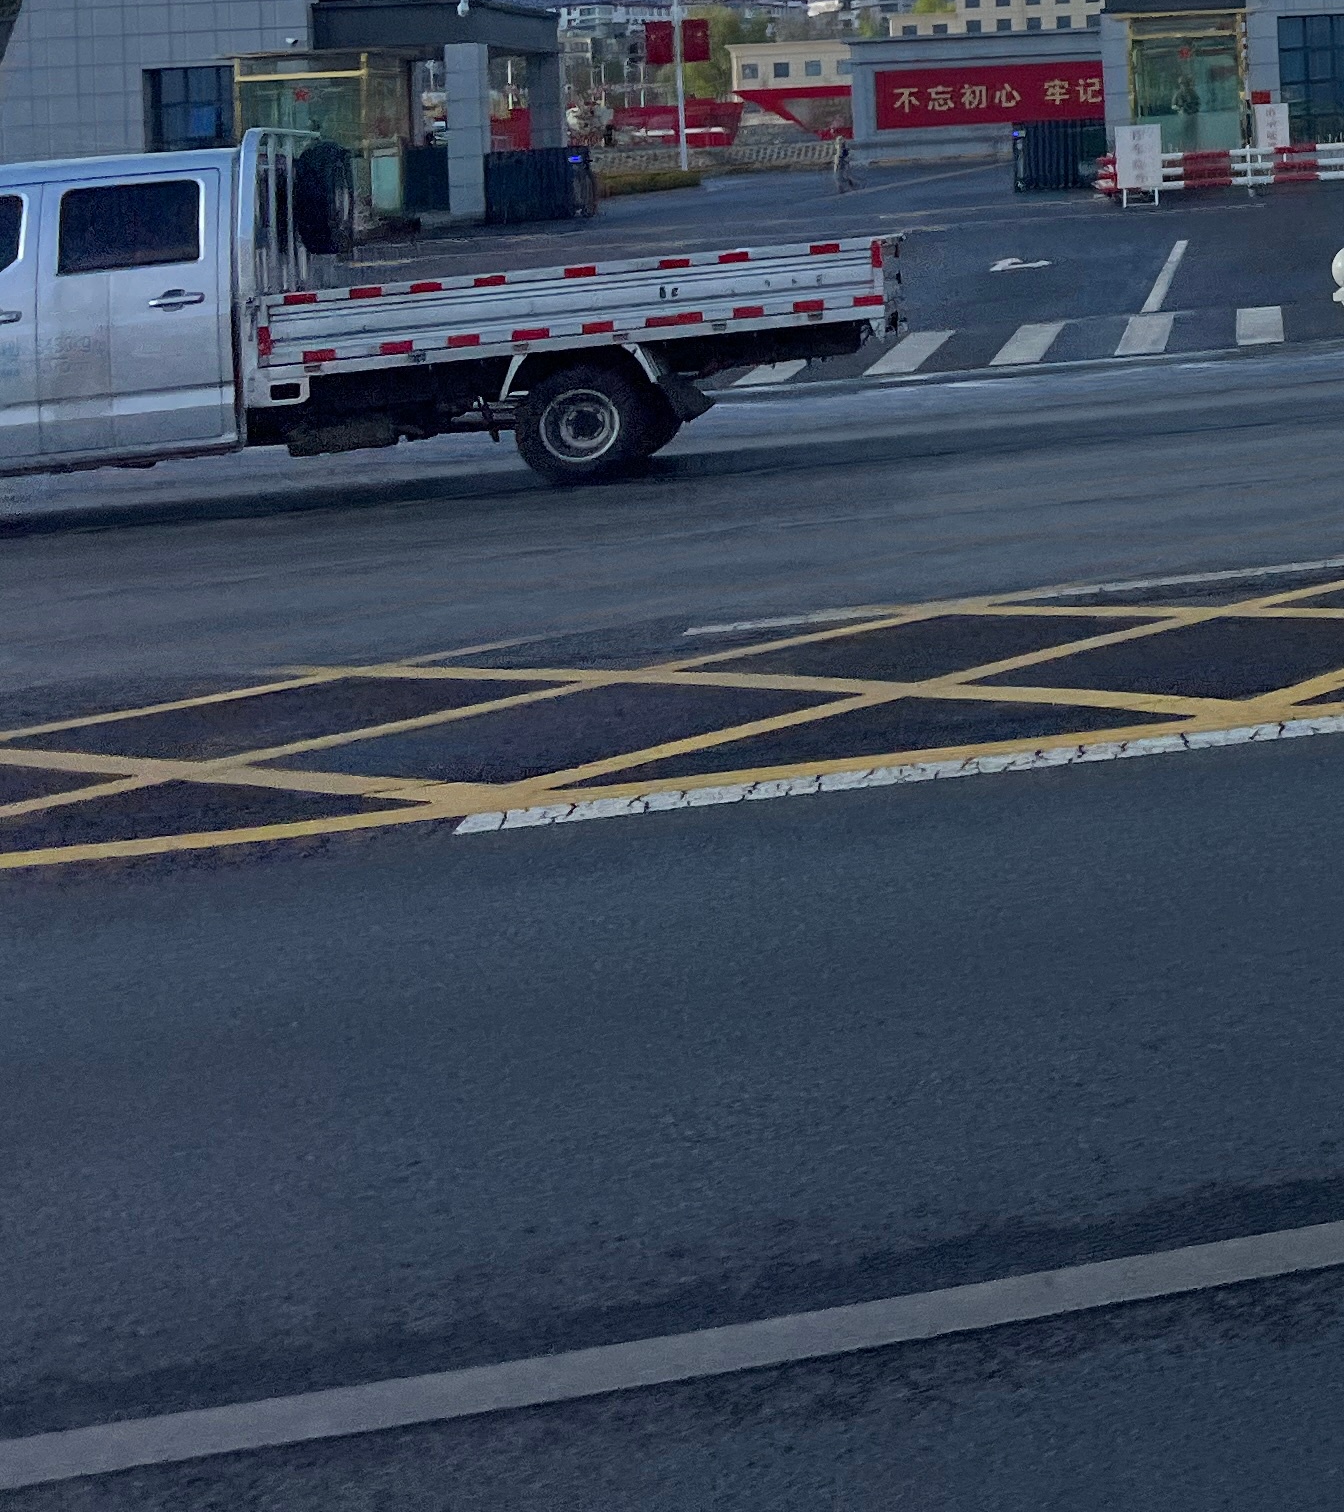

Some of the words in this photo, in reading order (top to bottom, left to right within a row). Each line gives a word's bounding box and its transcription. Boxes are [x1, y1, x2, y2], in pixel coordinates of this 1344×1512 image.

[893, 83, 1022, 113] 不忘初心
[1043, 78, 1103, 106] 牢记
